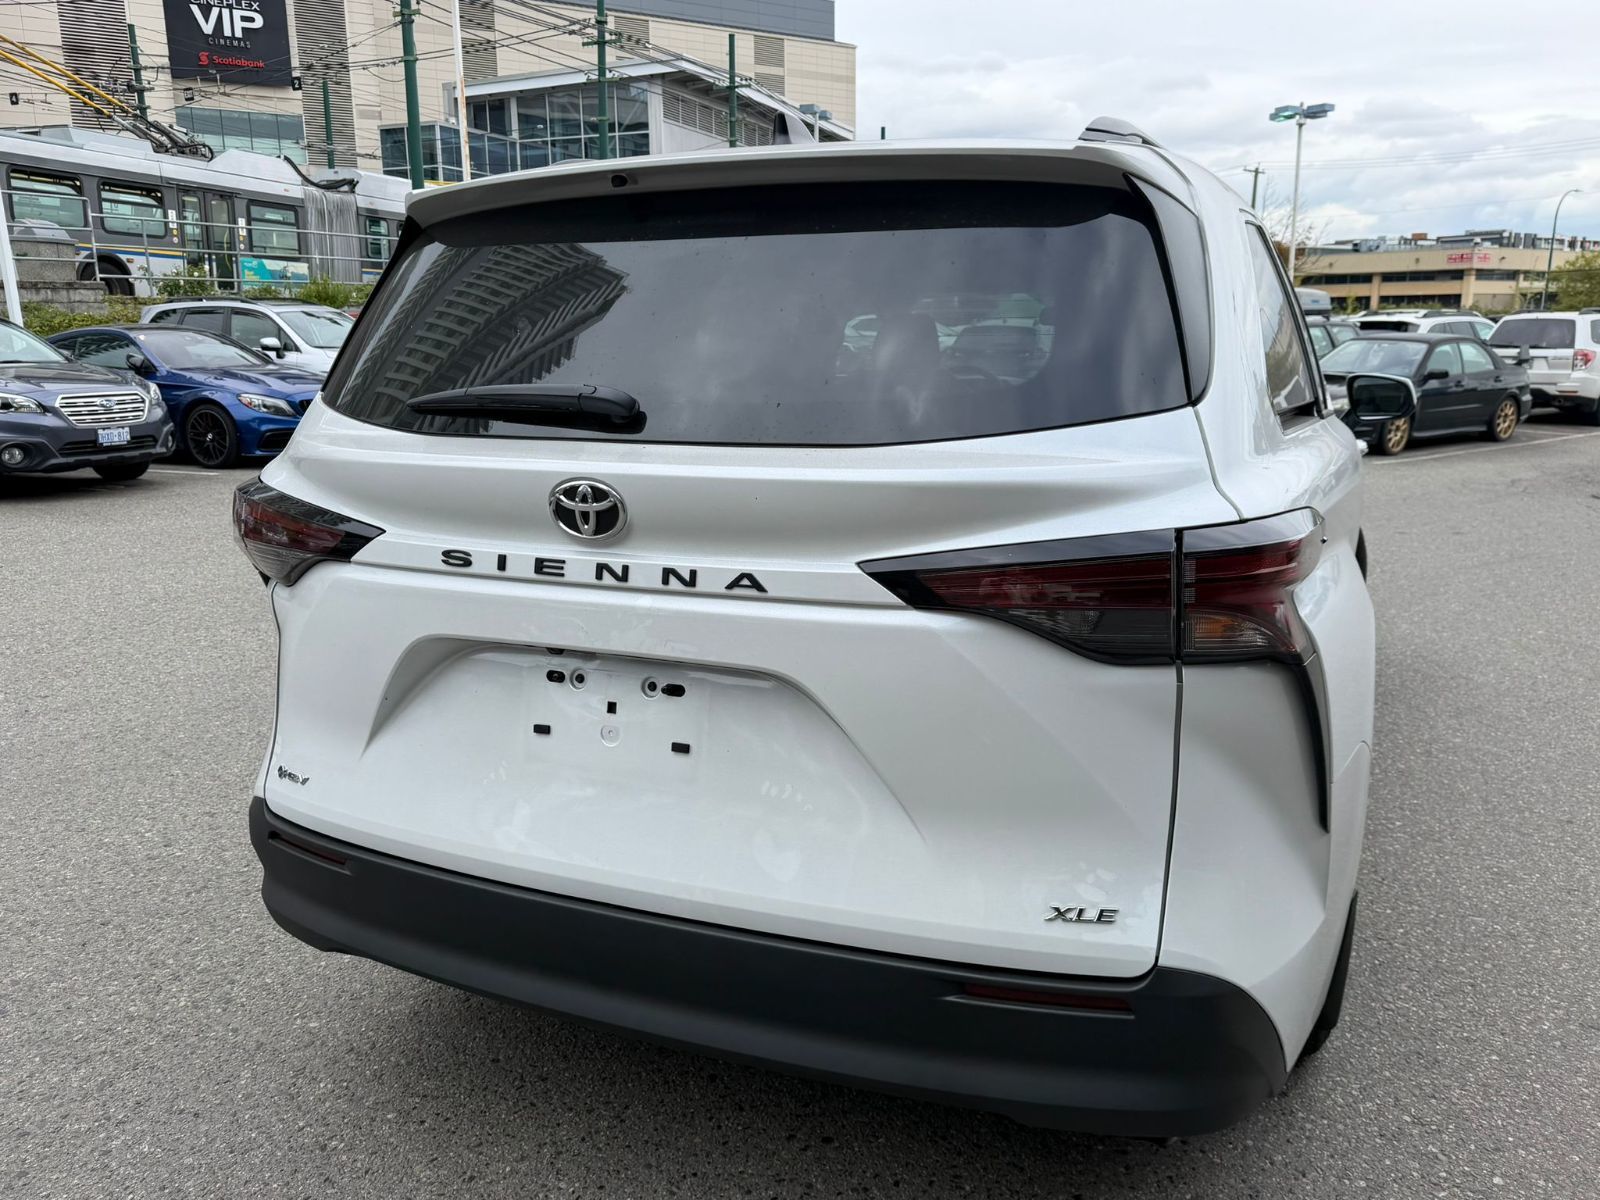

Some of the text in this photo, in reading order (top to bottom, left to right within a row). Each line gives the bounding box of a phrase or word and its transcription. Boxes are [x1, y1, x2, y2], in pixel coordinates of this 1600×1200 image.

[189, 4, 264, 38] VIP
[208, 37, 251, 49] CINEMAS
[212, 55, 265, 69] Scotiabank
[441, 549, 768, 593] SIENNA
[1043, 905, 1120, 924] XLE
